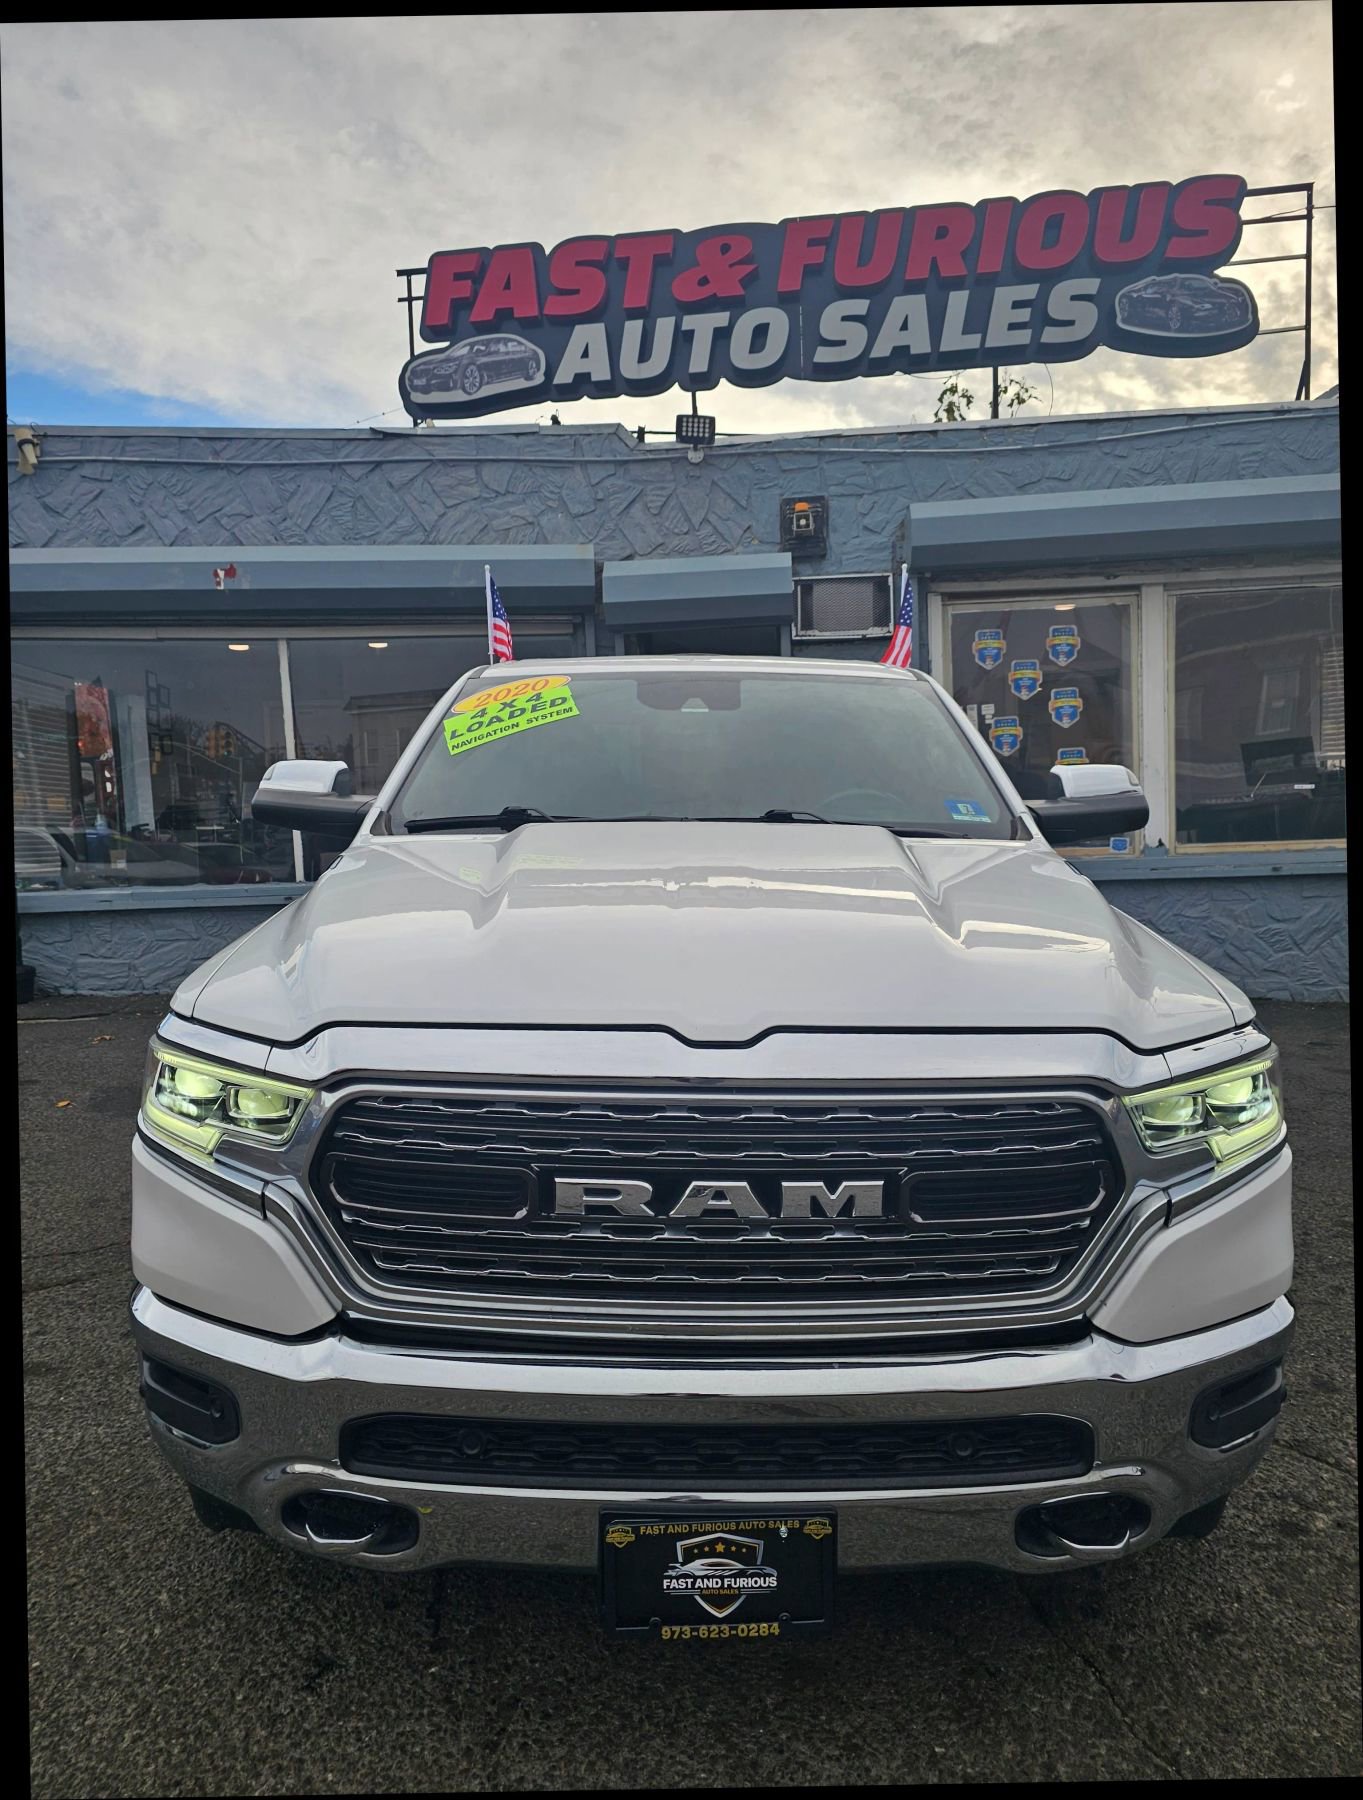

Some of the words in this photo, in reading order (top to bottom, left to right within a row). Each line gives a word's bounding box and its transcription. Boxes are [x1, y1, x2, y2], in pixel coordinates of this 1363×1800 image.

[425, 233, 674, 328] FAST
[671, 234, 758, 302] &
[777, 177, 1243, 293] FURIOUS
[552, 306, 790, 386] AUTO
[812, 278, 1102, 364] SALES
[473, 679, 550, 709] 2020
[449, 696, 568, 741] LOADED
[451, 722, 520, 751] NAVIGATION
[526, 706, 573, 724] SYSTEM
[554, 1177, 885, 1218] RAM
[639, 1525, 666, 1535] FAST
[667, 1524, 689, 1533] AND
[691, 1522, 737, 1533] FURIOUS
[738, 1521, 766, 1530] AUTO
[768, 1520, 800, 1529] SALES
[663, 1578, 693, 1589] FAST
[694, 1578, 722, 1589] AND
[723, 1576, 778, 1588] FURIOUS
[661, 1623, 780, 1640] 973-623-0284
